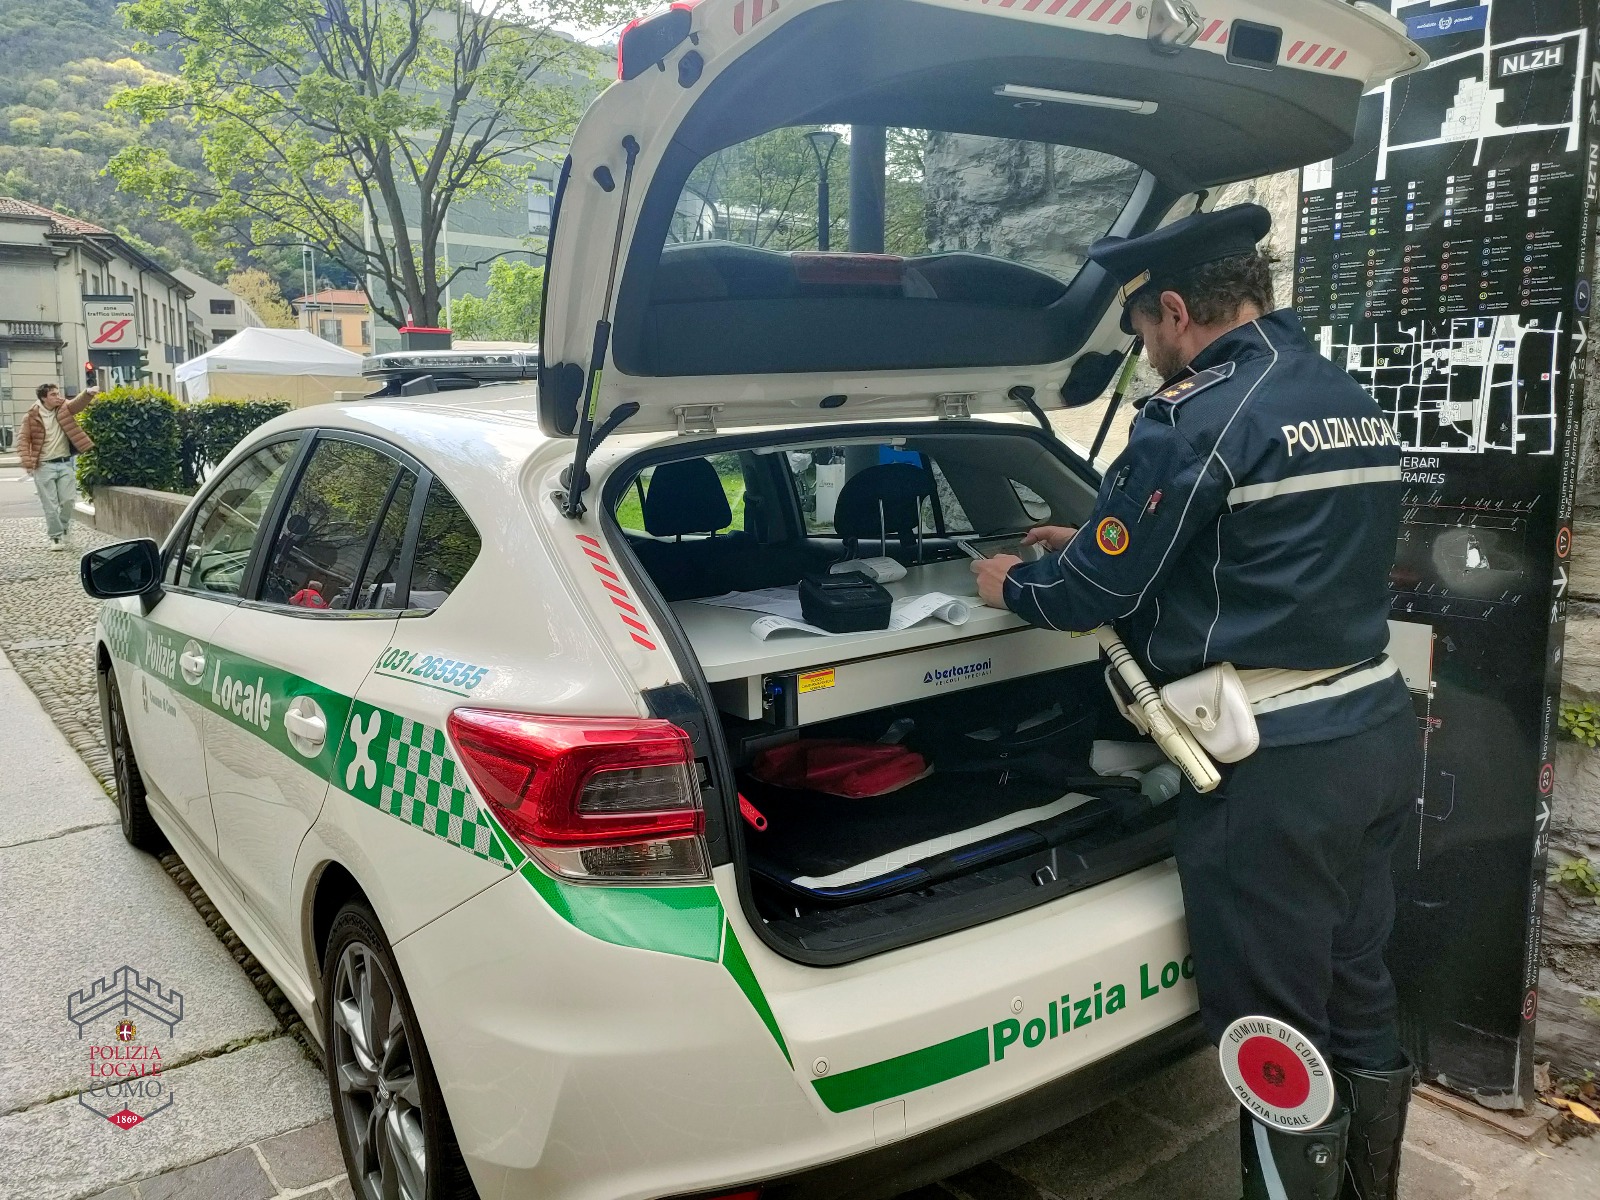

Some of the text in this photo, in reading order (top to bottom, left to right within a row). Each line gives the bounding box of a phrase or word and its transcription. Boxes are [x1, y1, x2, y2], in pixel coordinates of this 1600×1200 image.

[1502, 47, 1561, 74] NLZH
[1586, 143, 1599, 200] NLZH
[1578, 199, 1590, 273] Sant'Abbond
[1579, 291, 1586, 300] 7
[1281, 416, 1401, 457] POLIZIA LOCAL
[1558, 460, 1569, 519] Monumento
[1565, 383, 1575, 437] Resistenza
[1400, 457, 1440, 468] ERARI
[1401, 472, 1446, 484] RARIES
[1565, 420, 1579, 519] Resistance Memorial
[1560, 536, 1567, 551] 17
[145, 630, 177, 680] Polizia
[211, 659, 271, 732] Locale
[382, 648, 490, 690] 031.265555
[934, 658, 992, 680] bertazzoni
[1541, 696, 1552, 761] Novocomum
[1542, 771, 1550, 787] 23
[1530, 879, 1538, 913] Caduti
[1526, 926, 1535, 988] Monumento
[1533, 916, 1541, 962] Memorial
[993, 953, 1195, 1063] Polizia Loc
[1229, 1021, 1324, 1077] COMUNE DI COMO
[1235, 1085, 1311, 1126] POLIZIA LOCALE
